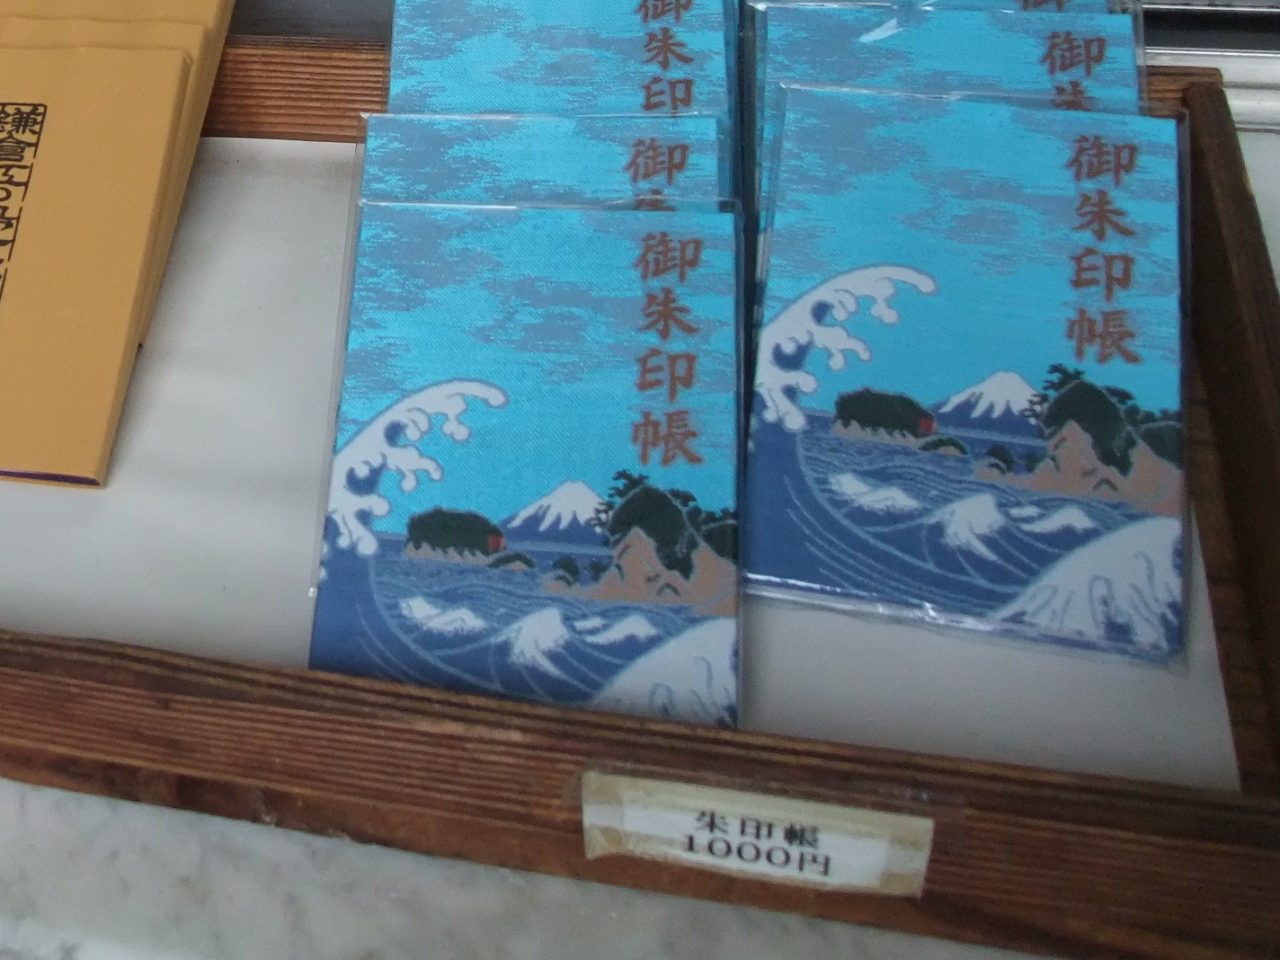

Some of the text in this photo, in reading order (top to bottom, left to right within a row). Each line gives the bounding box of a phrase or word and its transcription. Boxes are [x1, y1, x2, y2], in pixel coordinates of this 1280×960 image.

[1064, 134, 1140, 368] 御朱印帳
[632, 231, 705, 467] 御朱印帳
[684, 835, 830, 876] 1000円
[696, 811, 819, 847] 朱印帳
